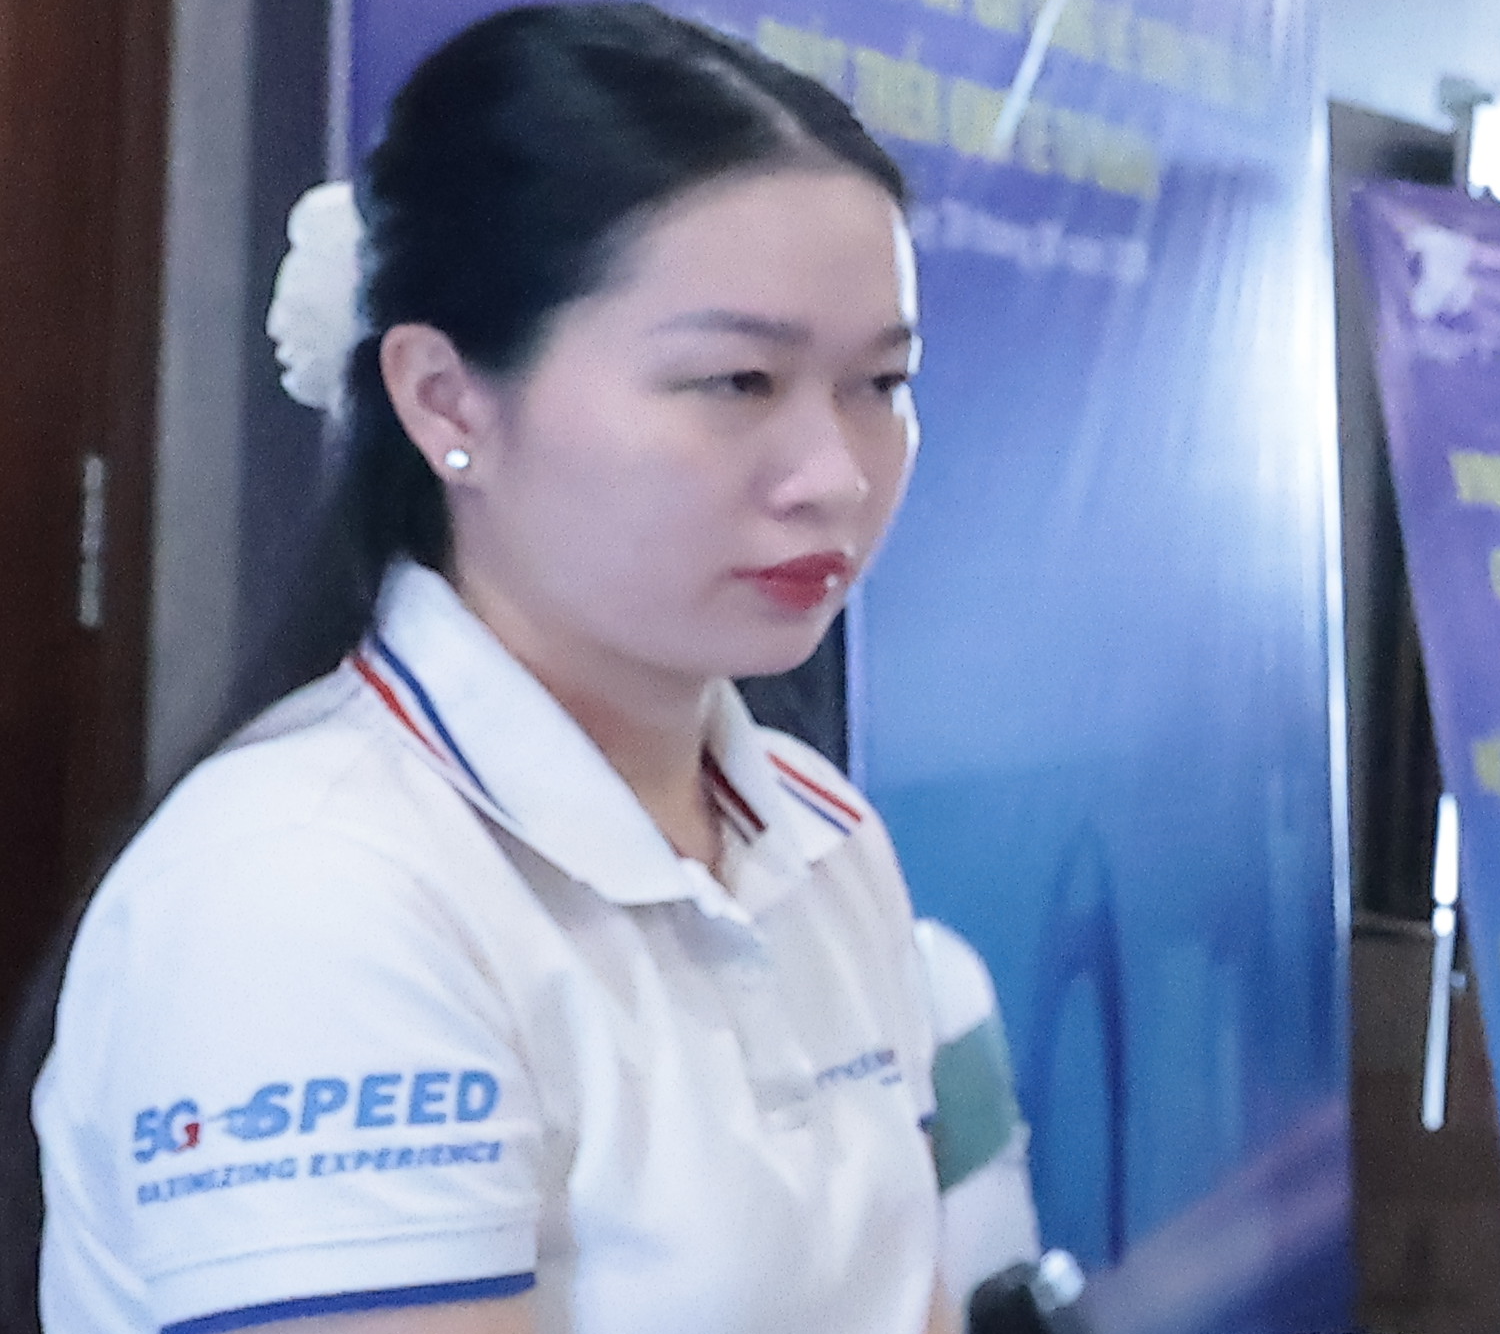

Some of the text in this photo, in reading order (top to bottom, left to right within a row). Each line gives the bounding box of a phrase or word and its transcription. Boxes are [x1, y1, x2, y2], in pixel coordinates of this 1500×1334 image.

[133, 1069, 499, 1164] 5G SPEED
[308, 1141, 501, 1178] EXPERIENCE
